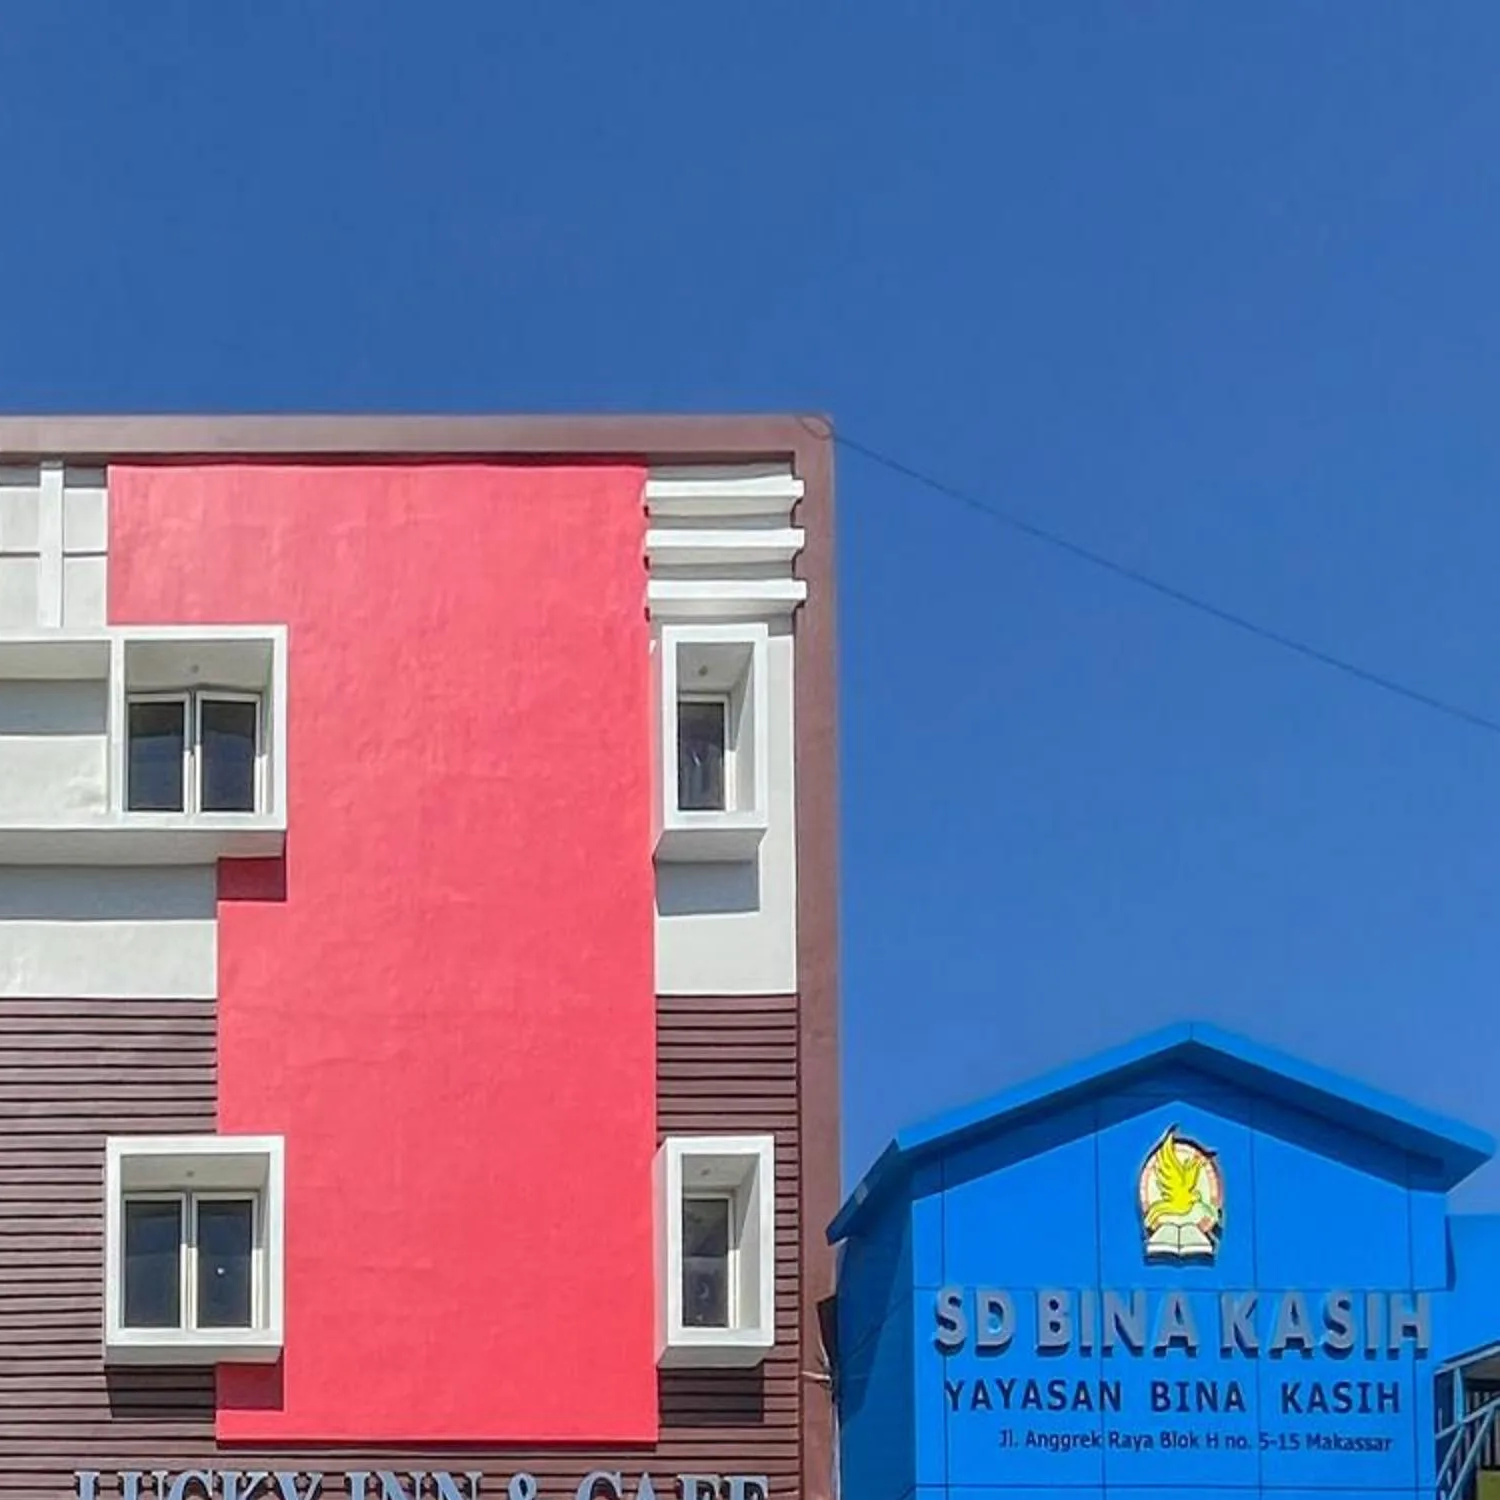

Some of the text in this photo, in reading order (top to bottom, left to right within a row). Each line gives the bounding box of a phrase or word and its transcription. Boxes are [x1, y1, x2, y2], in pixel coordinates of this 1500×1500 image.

[934, 1286, 1432, 1355] SD BINA KASIH
[944, 1378, 1401, 1414] YAYASAN BINA KASIH
[1026, 1430, 1102, 1451] Anggrek
[1109, 1431, 1153, 1452] Raya
[1160, 1431, 1200, 1449] Blok
[1259, 1433, 1300, 1450] 5-15
[1306, 1433, 1392, 1452] Makassar
